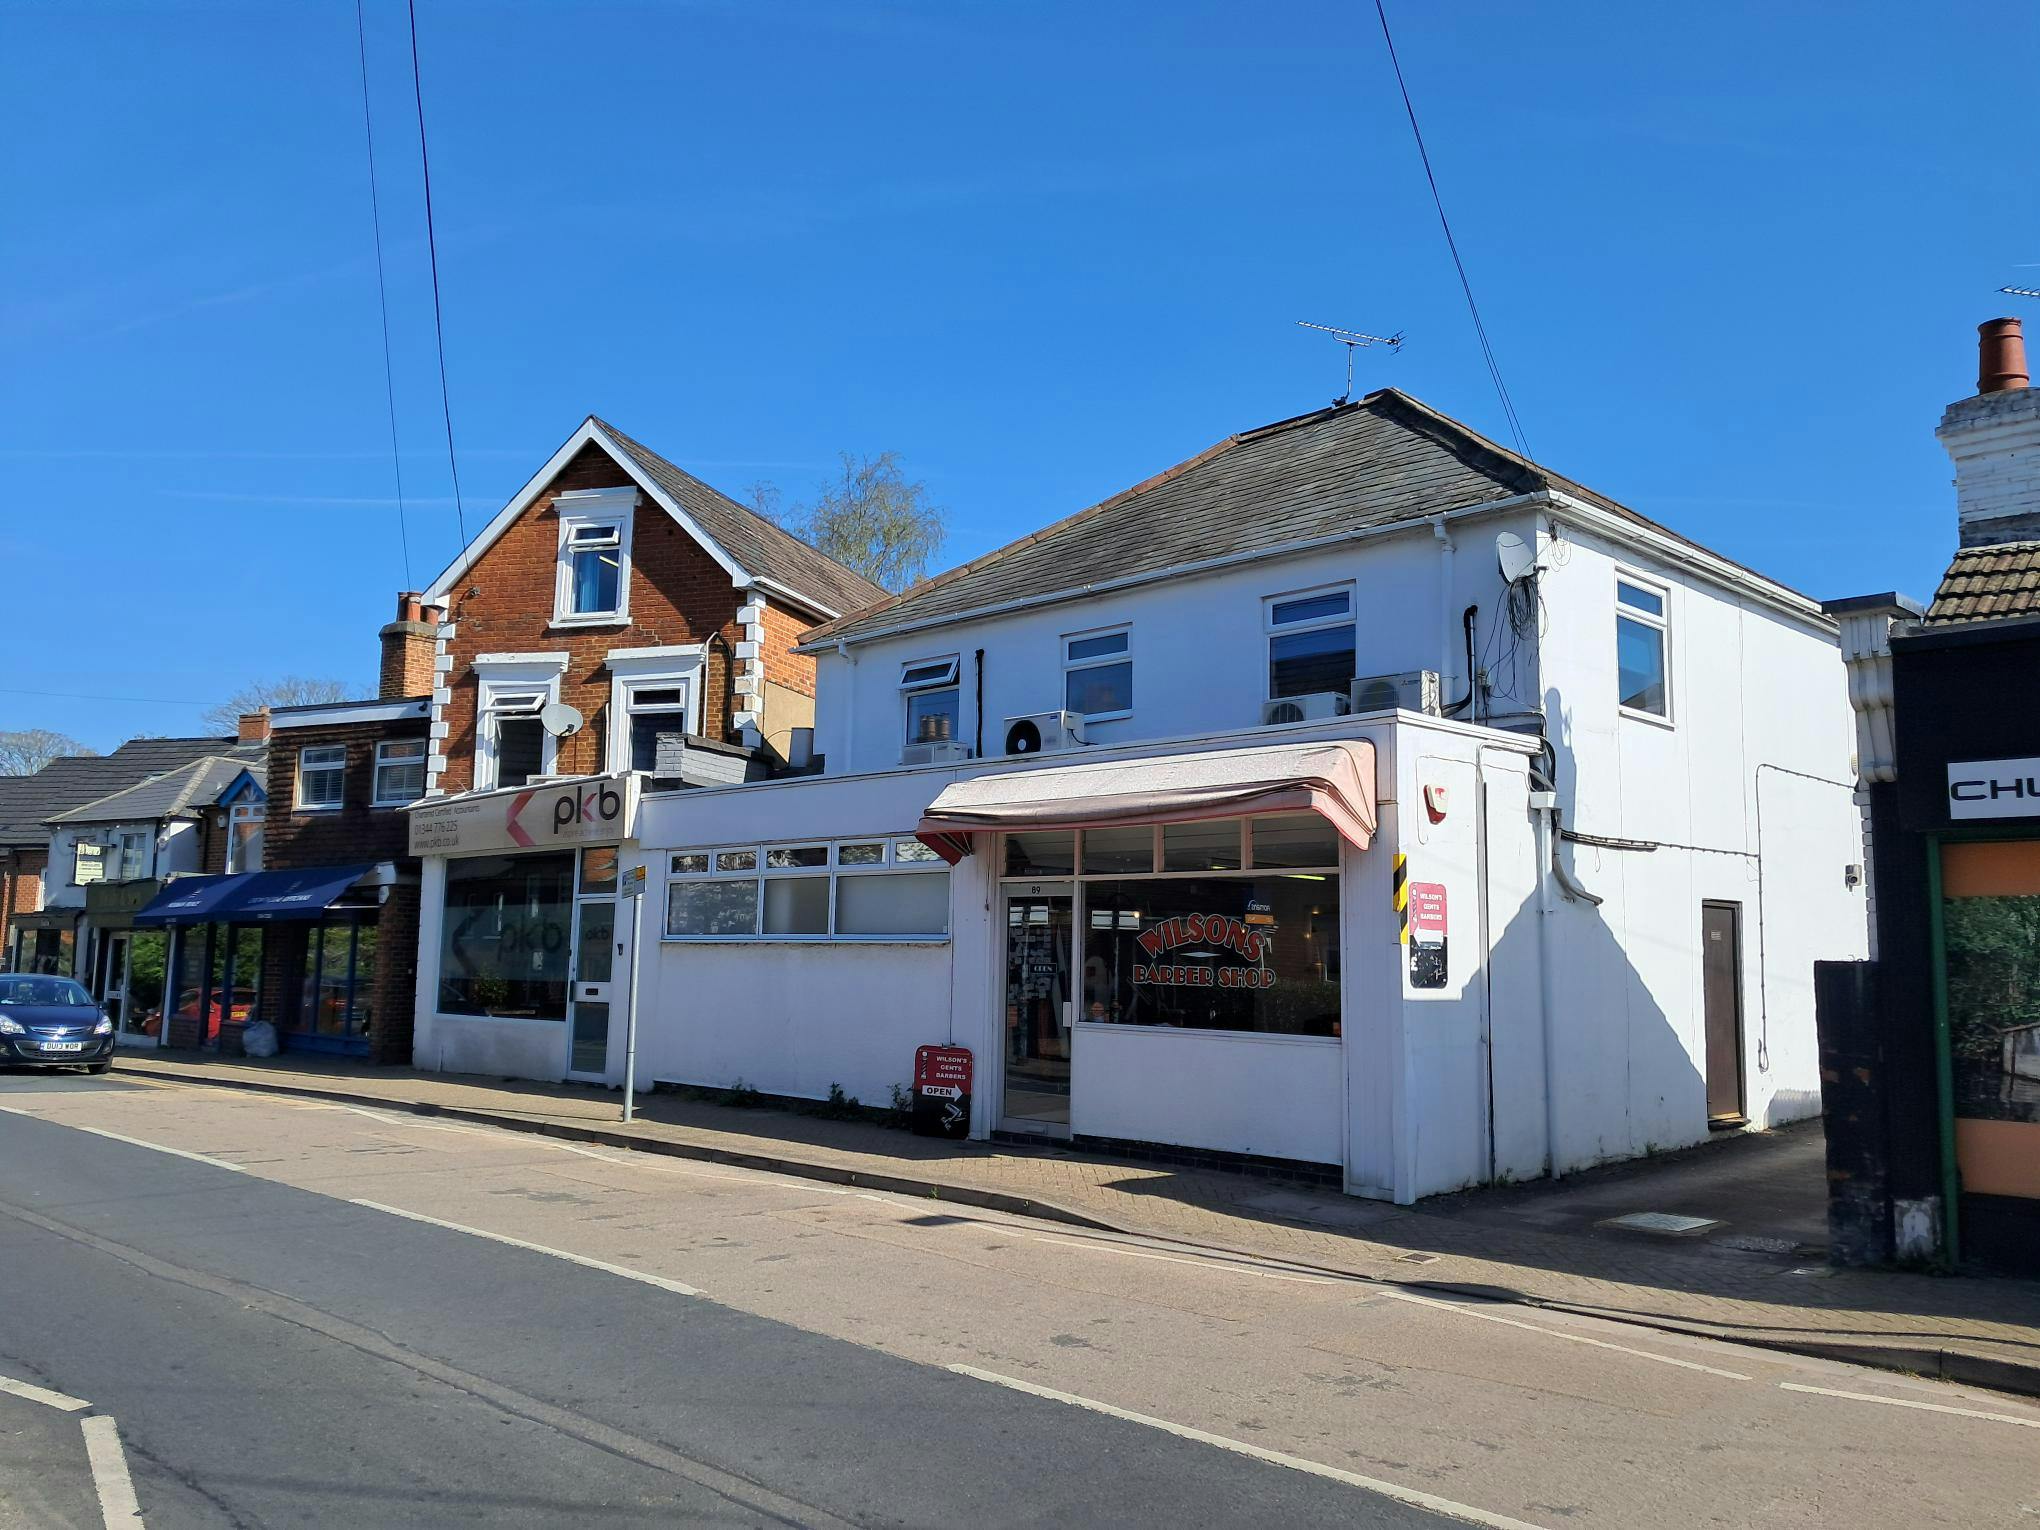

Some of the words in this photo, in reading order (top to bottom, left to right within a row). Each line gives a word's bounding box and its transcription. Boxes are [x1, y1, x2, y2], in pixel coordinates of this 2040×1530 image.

[553, 783, 620, 834] pkb
[415, 823, 433, 835] 01344
[434, 822, 445, 833] 776
[446, 820, 458, 832] 225
[415, 834, 459, 850] www.pkb.co.uk
[1032, 886, 1041, 894] 89
[1419, 893, 1443, 901] WILSON'S
[1423, 903, 1440, 911] GENTS
[1420, 913, 1443, 921] BARBERS
[498, 912, 562, 962] pkb
[1132, 963, 1214, 987] BARBER
[1217, 966, 1277, 989] SHOP
[936, 1056, 968, 1064] WILSON'S
[940, 1064, 962, 1072] GENTS
[935, 1072, 966, 1080] BARBERS
[926, 1087, 952, 1096] OPEN
